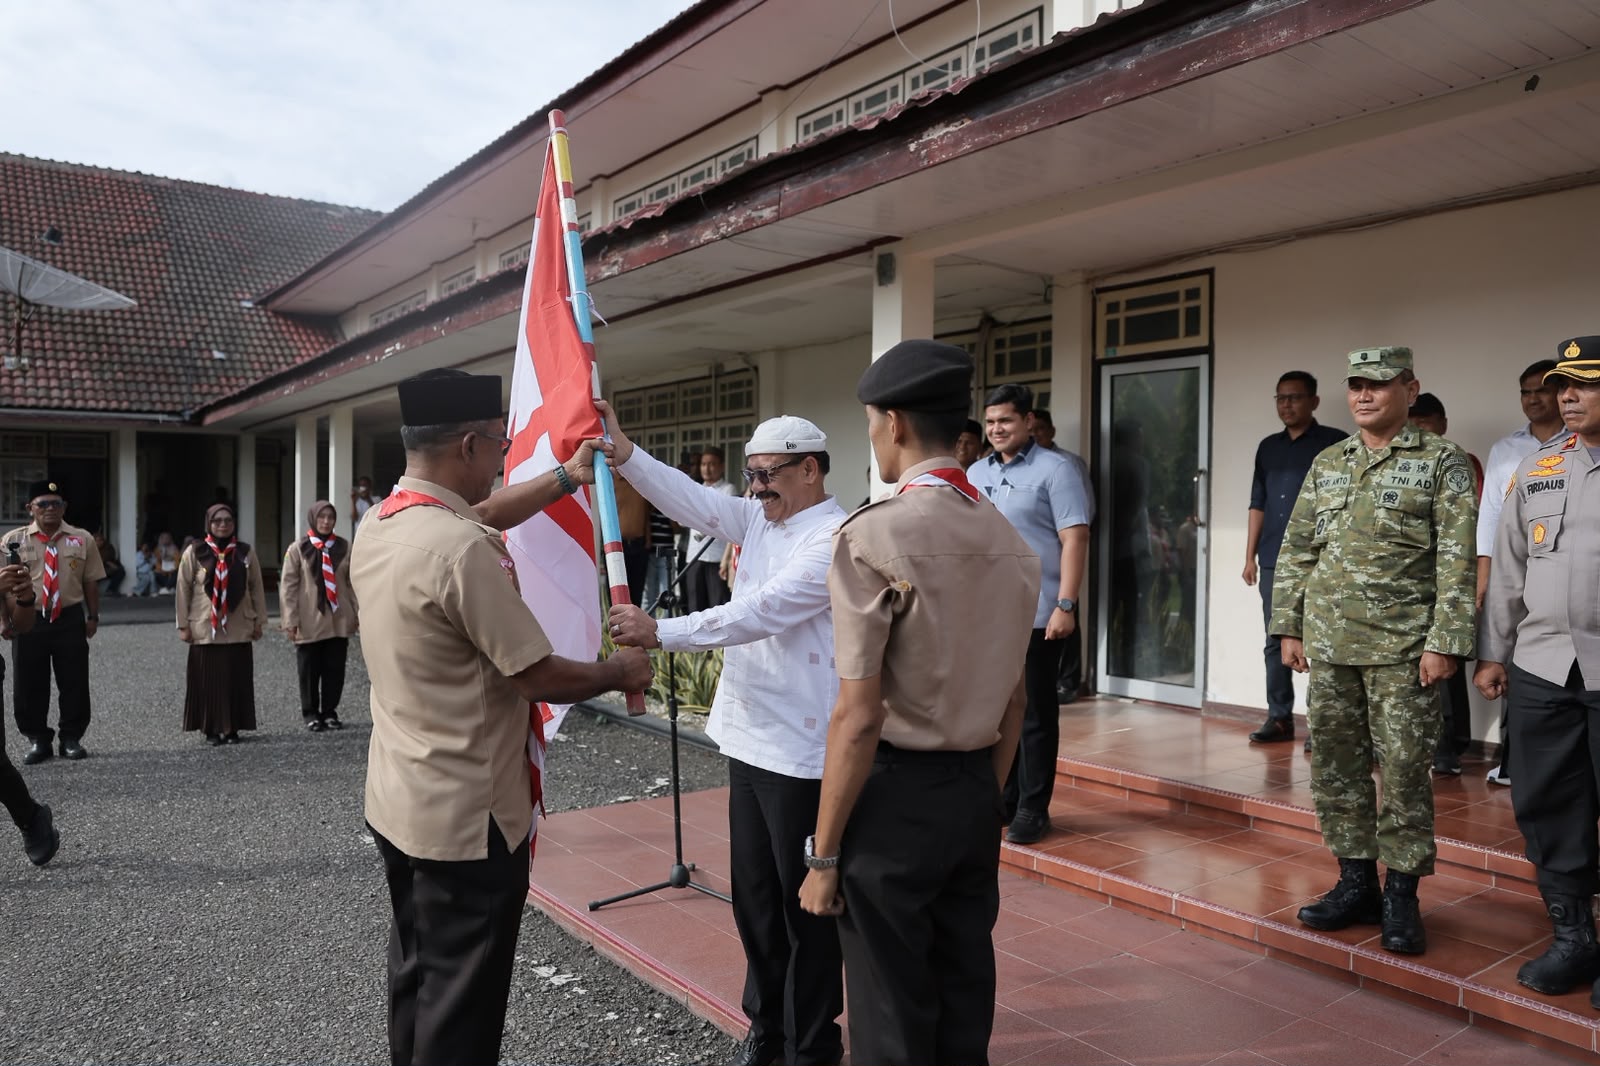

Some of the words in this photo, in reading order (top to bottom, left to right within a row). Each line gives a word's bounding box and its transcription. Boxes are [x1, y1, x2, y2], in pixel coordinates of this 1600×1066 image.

[1391, 476, 1410, 486] TNI
[1414, 479, 1432, 489] AD
[1526, 479, 1565, 496] FIRDAUS
